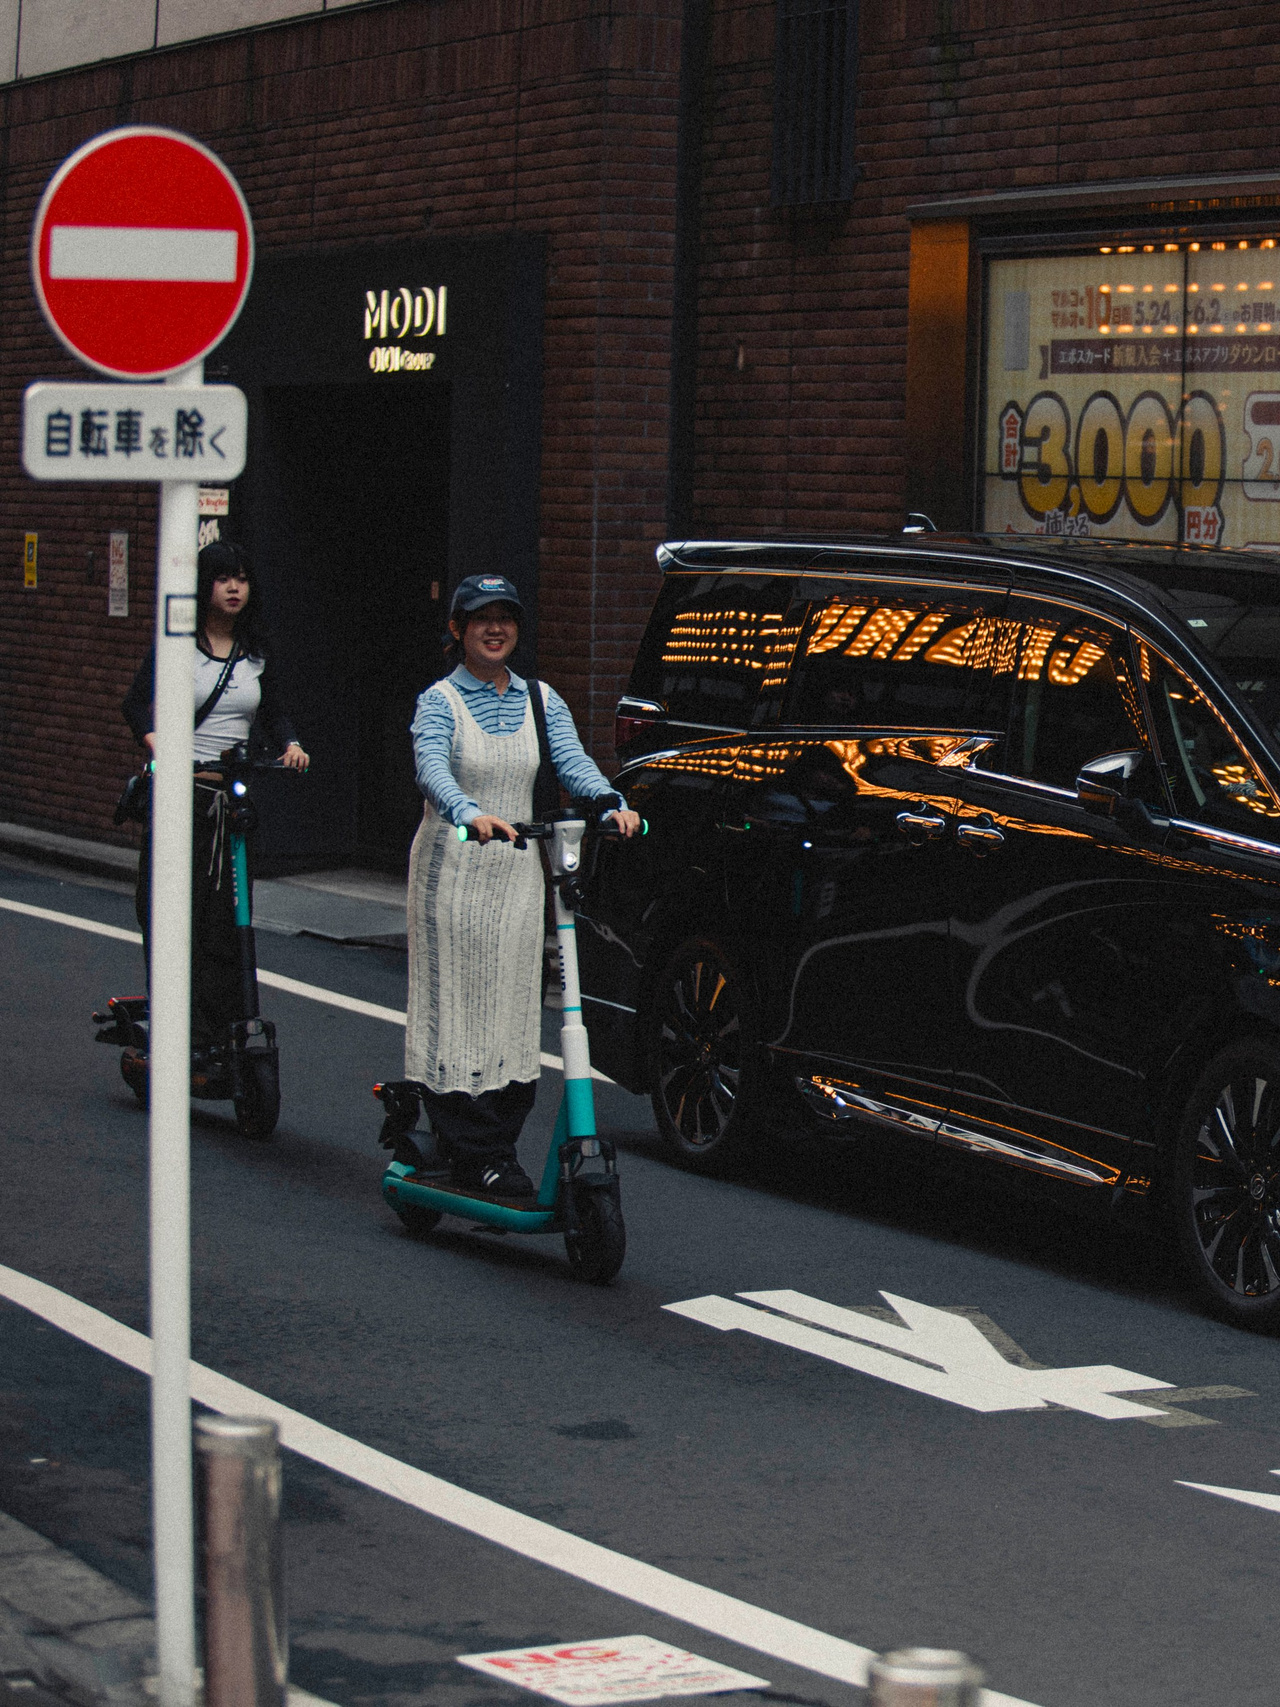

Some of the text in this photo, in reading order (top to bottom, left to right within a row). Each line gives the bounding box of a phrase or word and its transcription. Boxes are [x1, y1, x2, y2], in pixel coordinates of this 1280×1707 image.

[364, 285, 447, 340] MODI
[46, 408, 227, 459] 自転車を除く
[1004, 413, 1020, 469] 合計
[1019, 390, 1227, 526] 3,000
[1186, 510, 1219, 540] 円分
